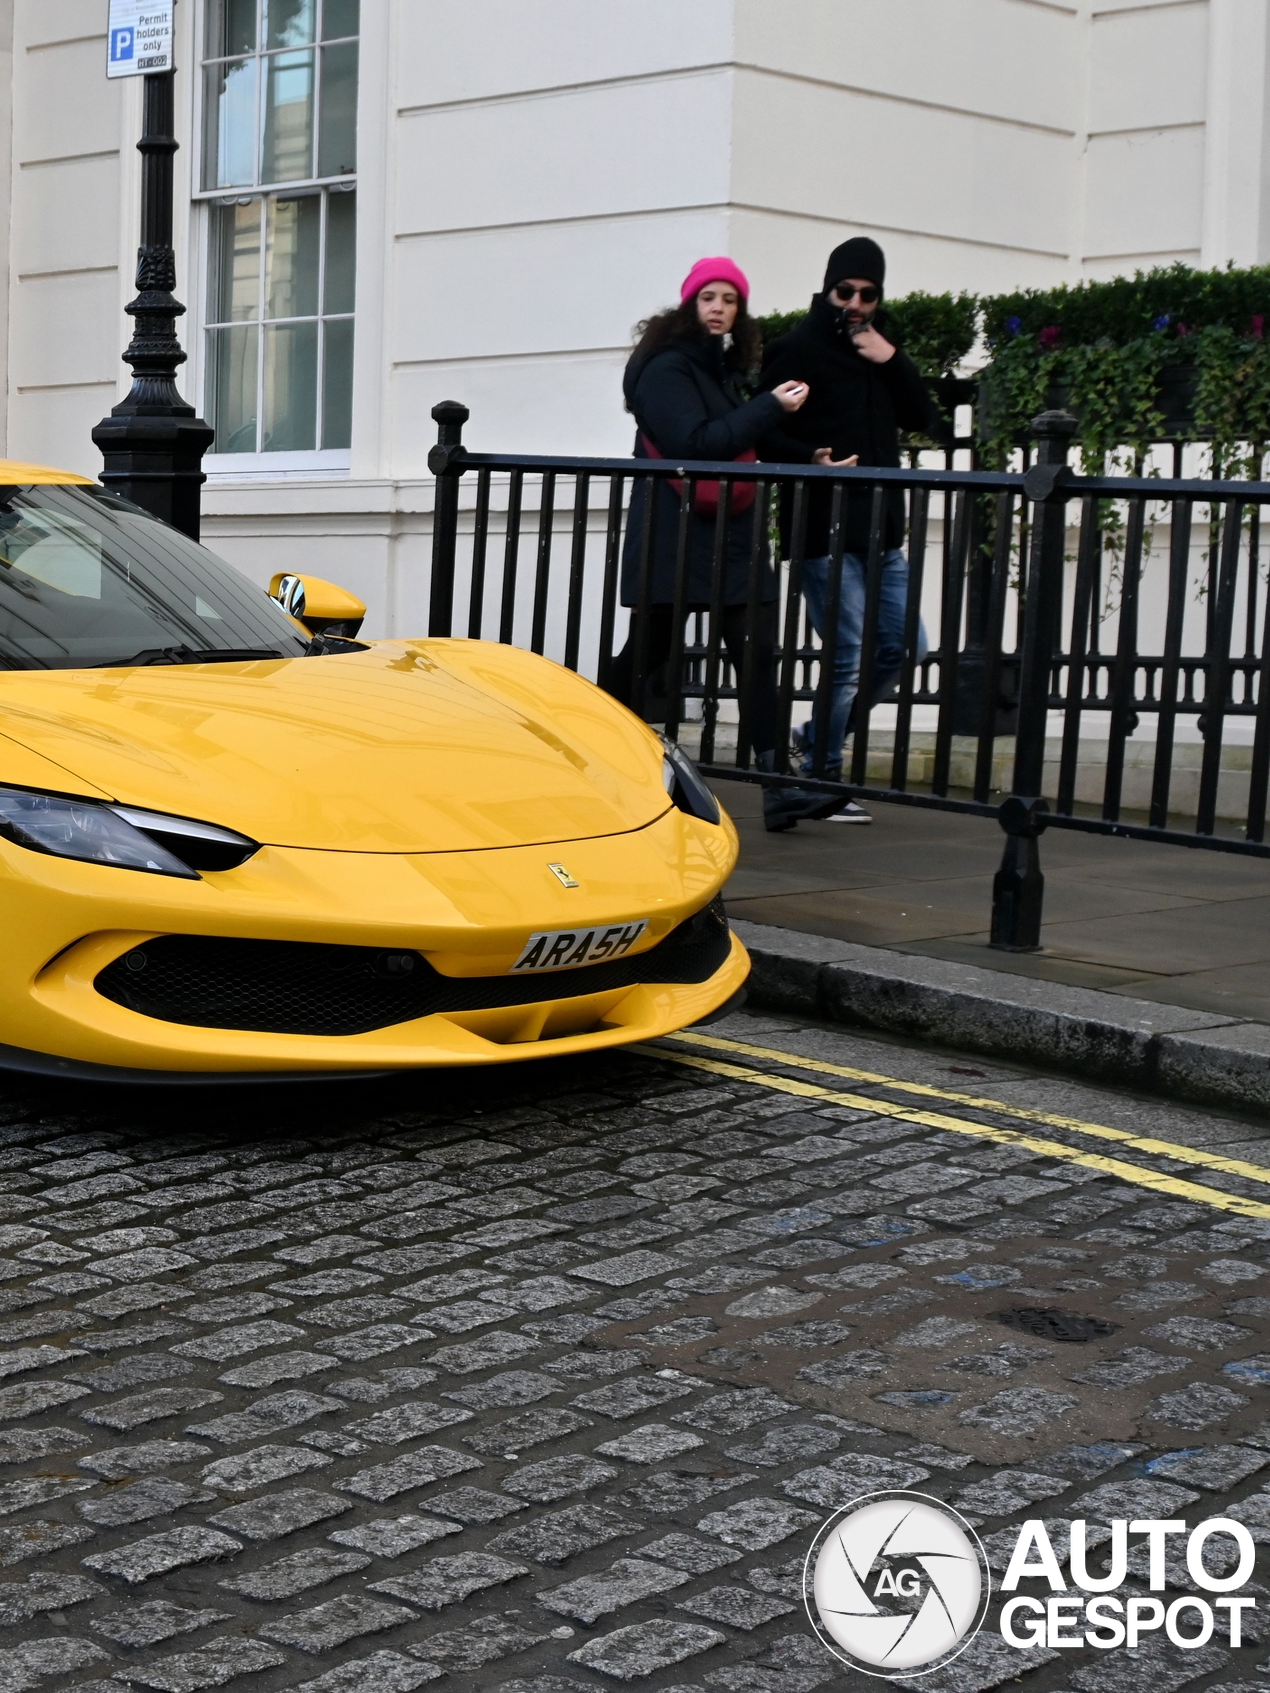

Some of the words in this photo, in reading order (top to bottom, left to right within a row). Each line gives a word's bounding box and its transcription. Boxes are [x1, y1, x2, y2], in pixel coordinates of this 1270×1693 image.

[139, 12, 167, 25] Permit
[137, 27, 169, 39] holders
[116, 31, 131, 59] P
[143, 40, 162, 52] only
[515, 923, 645, 969] ARA5H
